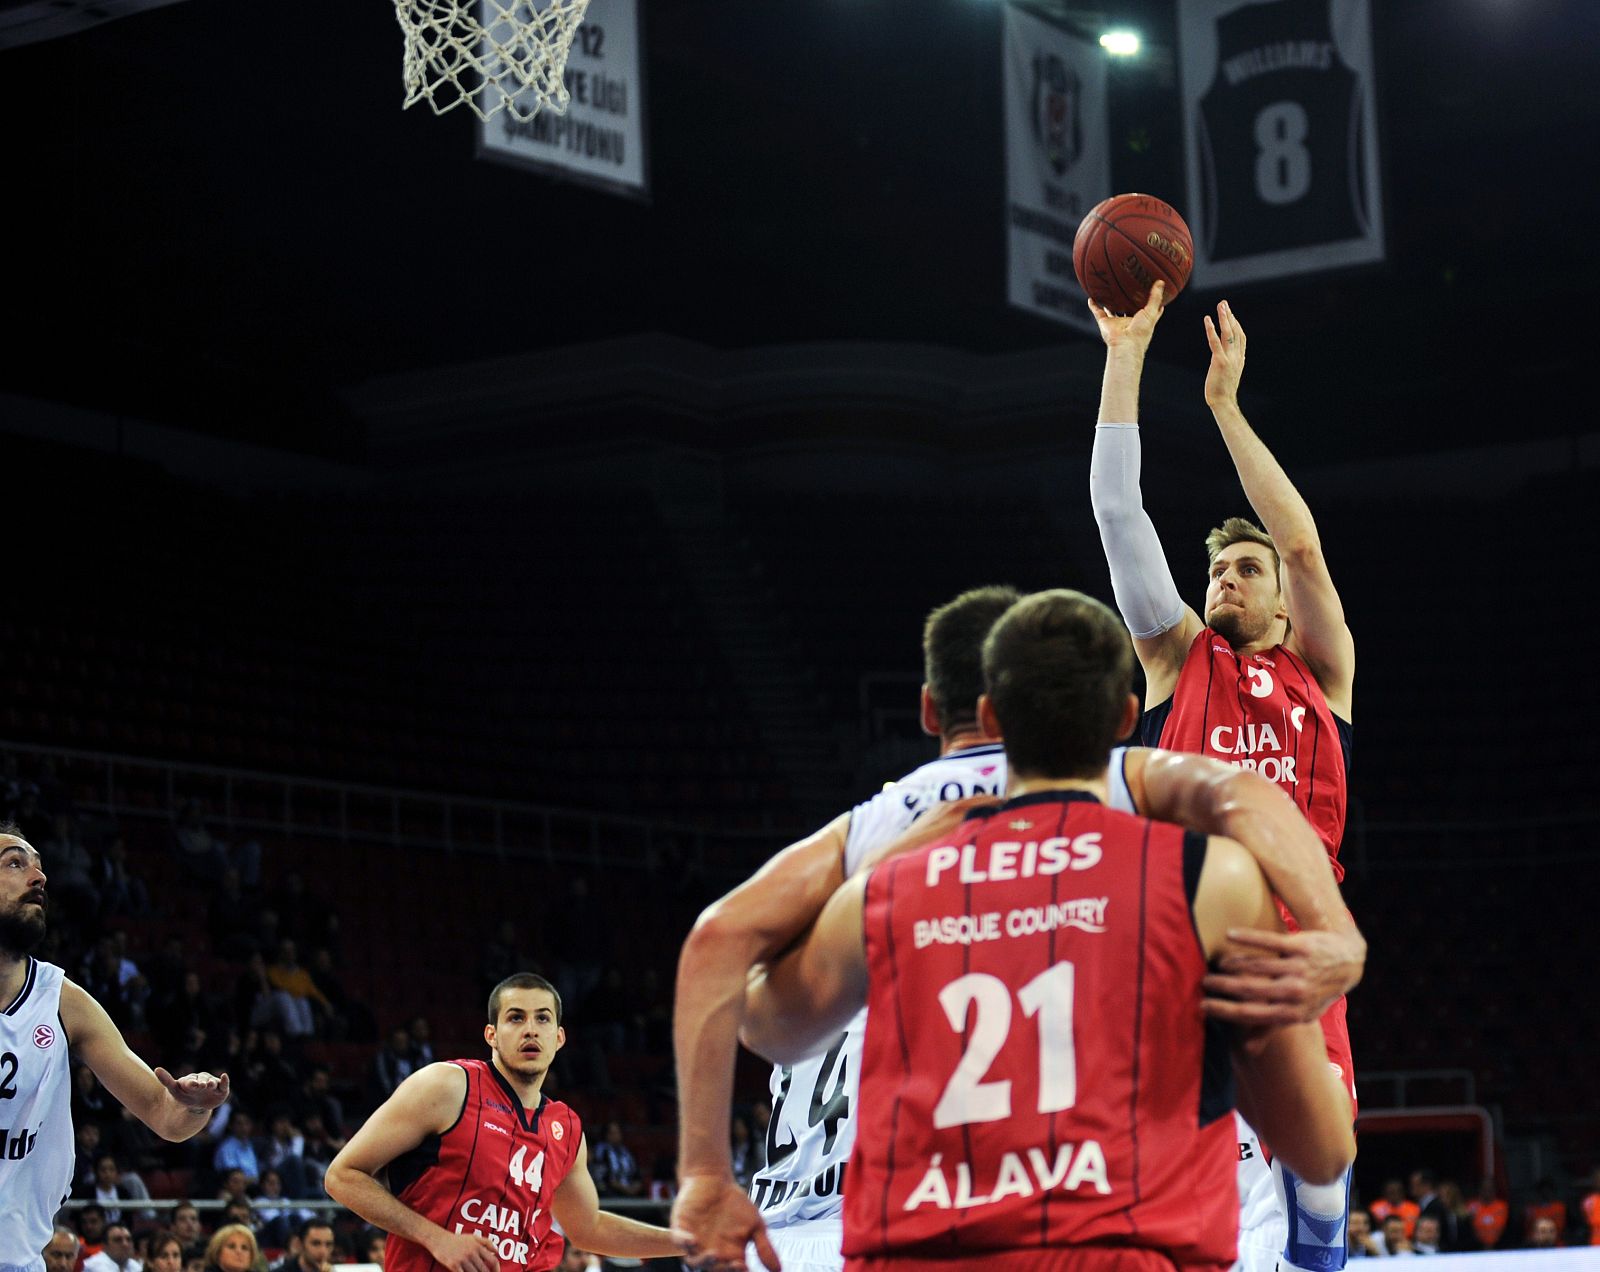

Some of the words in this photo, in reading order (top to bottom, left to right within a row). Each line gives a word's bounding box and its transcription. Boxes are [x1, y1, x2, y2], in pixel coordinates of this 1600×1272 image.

[1223, 41, 1333, 86] WILLIAMS
[1254, 102, 1312, 205] 8
[1210, 723, 1282, 755] CAJA
[926, 832, 1103, 887] PLEISS
[914, 912, 1001, 949] BASQUE
[1006, 897, 1110, 938] COUNTRY
[934, 960, 1076, 1130] 21
[509, 1144, 545, 1193] 44
[903, 1140, 1113, 1211] ÁLAVA
[460, 1198, 520, 1236] CAJA
